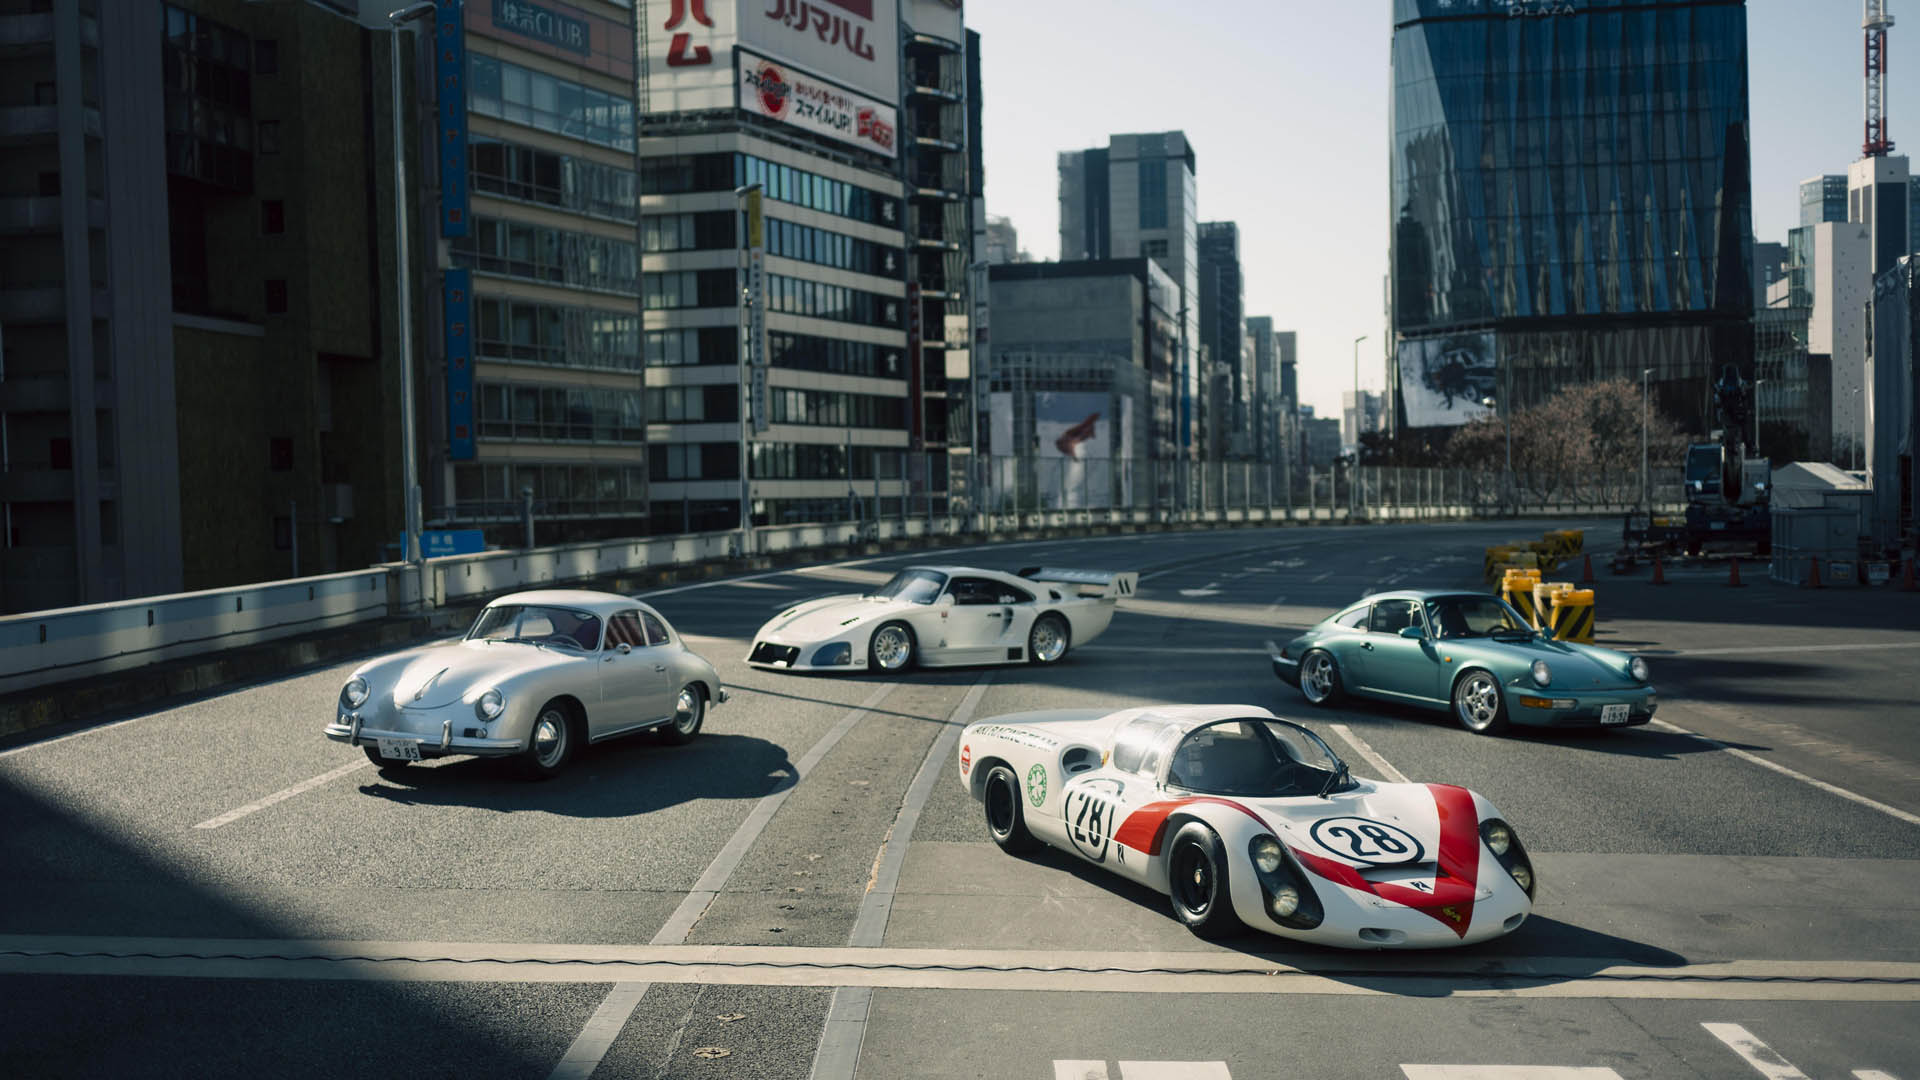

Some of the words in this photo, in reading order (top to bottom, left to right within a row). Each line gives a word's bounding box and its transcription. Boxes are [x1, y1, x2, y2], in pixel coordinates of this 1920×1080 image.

[1509, 4, 1576, 17] PLAZA
[1074, 791, 1106, 848] 28
[1328, 824, 1408, 857] 28
